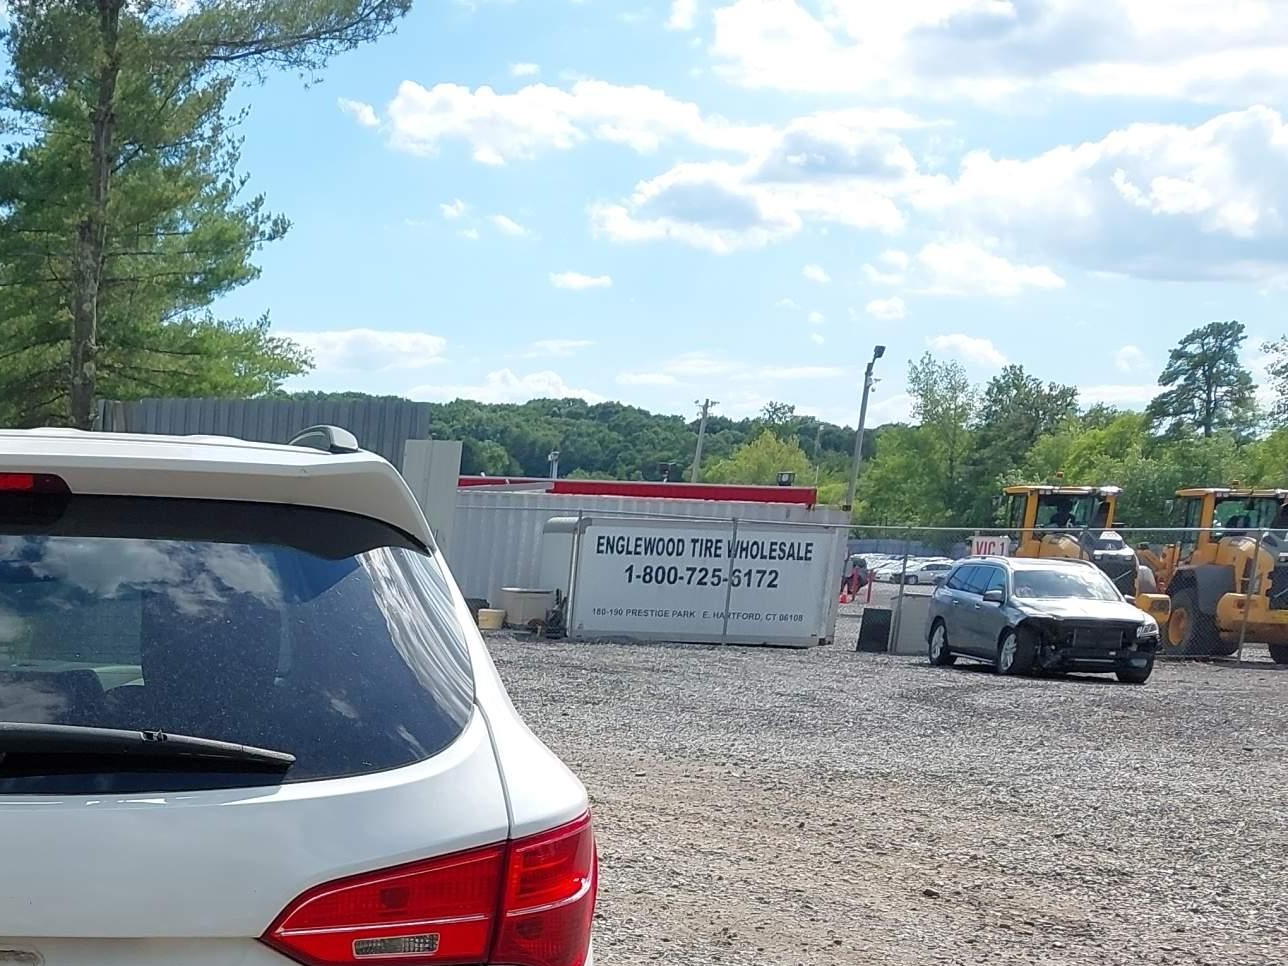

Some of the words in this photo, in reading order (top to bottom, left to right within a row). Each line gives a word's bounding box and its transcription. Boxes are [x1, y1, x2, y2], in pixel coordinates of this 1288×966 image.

[596, 535, 685, 557] ENGLEWOOD
[690, 537, 723, 558] TIRE
[727, 538, 814, 561] WHOLESALE
[976, 540, 996, 555] VIC
[999, 541, 1005, 556] 1
[624, 564, 779, 588] 1-800-725-6172
[592, 607, 623, 616] 180-190
[625, 608, 670, 618] PRESTIGE
[671, 609, 696, 618] PARK
[765, 612, 778, 621] CT
